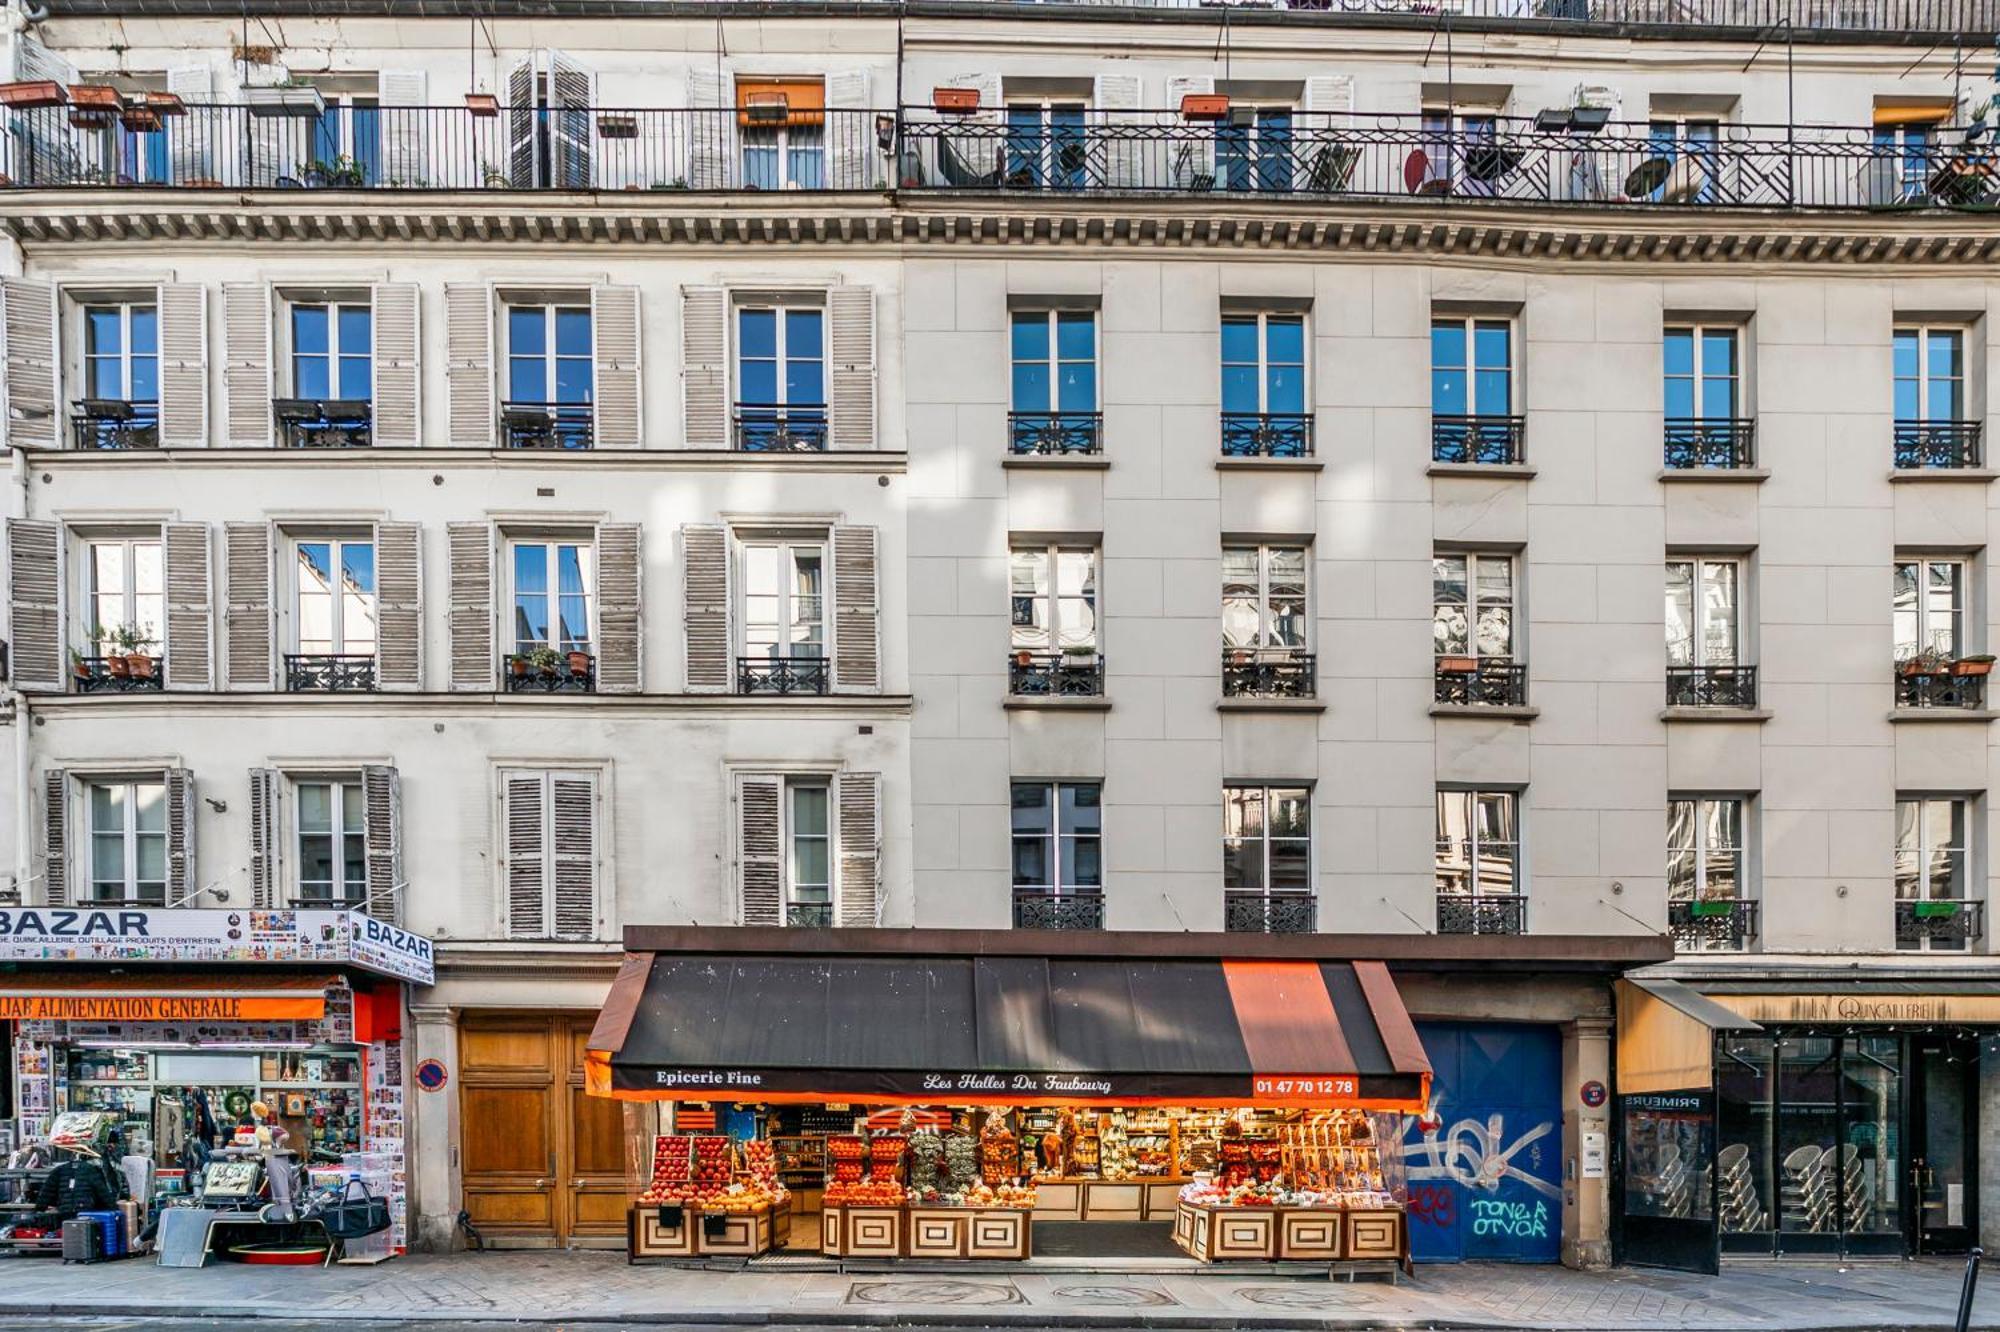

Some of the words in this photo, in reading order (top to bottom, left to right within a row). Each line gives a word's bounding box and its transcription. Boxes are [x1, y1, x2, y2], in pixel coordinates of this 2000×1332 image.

[0, 911, 149, 936] BAZAR
[125, 937, 166, 945] PRODUITS
[168, 937, 221, 945] D'ENTRETIEN
[367, 919, 429, 959] BAZAR
[38, 998, 153, 1018] ALIMENTATION
[656, 1070, 723, 1086] Epicerie
[727, 1071, 761, 1084] Fine
[923, 1074, 952, 1089] Les
[958, 1074, 1006, 1089] Halles
[1011, 1074, 1038, 1090] Du
[1044, 1075, 1112, 1093] Faubourg
[1256, 1081, 1272, 1093] 01
[1276, 1081, 1294, 1093] 47
[1296, 1081, 1314, 1093] 70
[1316, 1081, 1333, 1093] 12
[1335, 1081, 1353, 1093] 78
